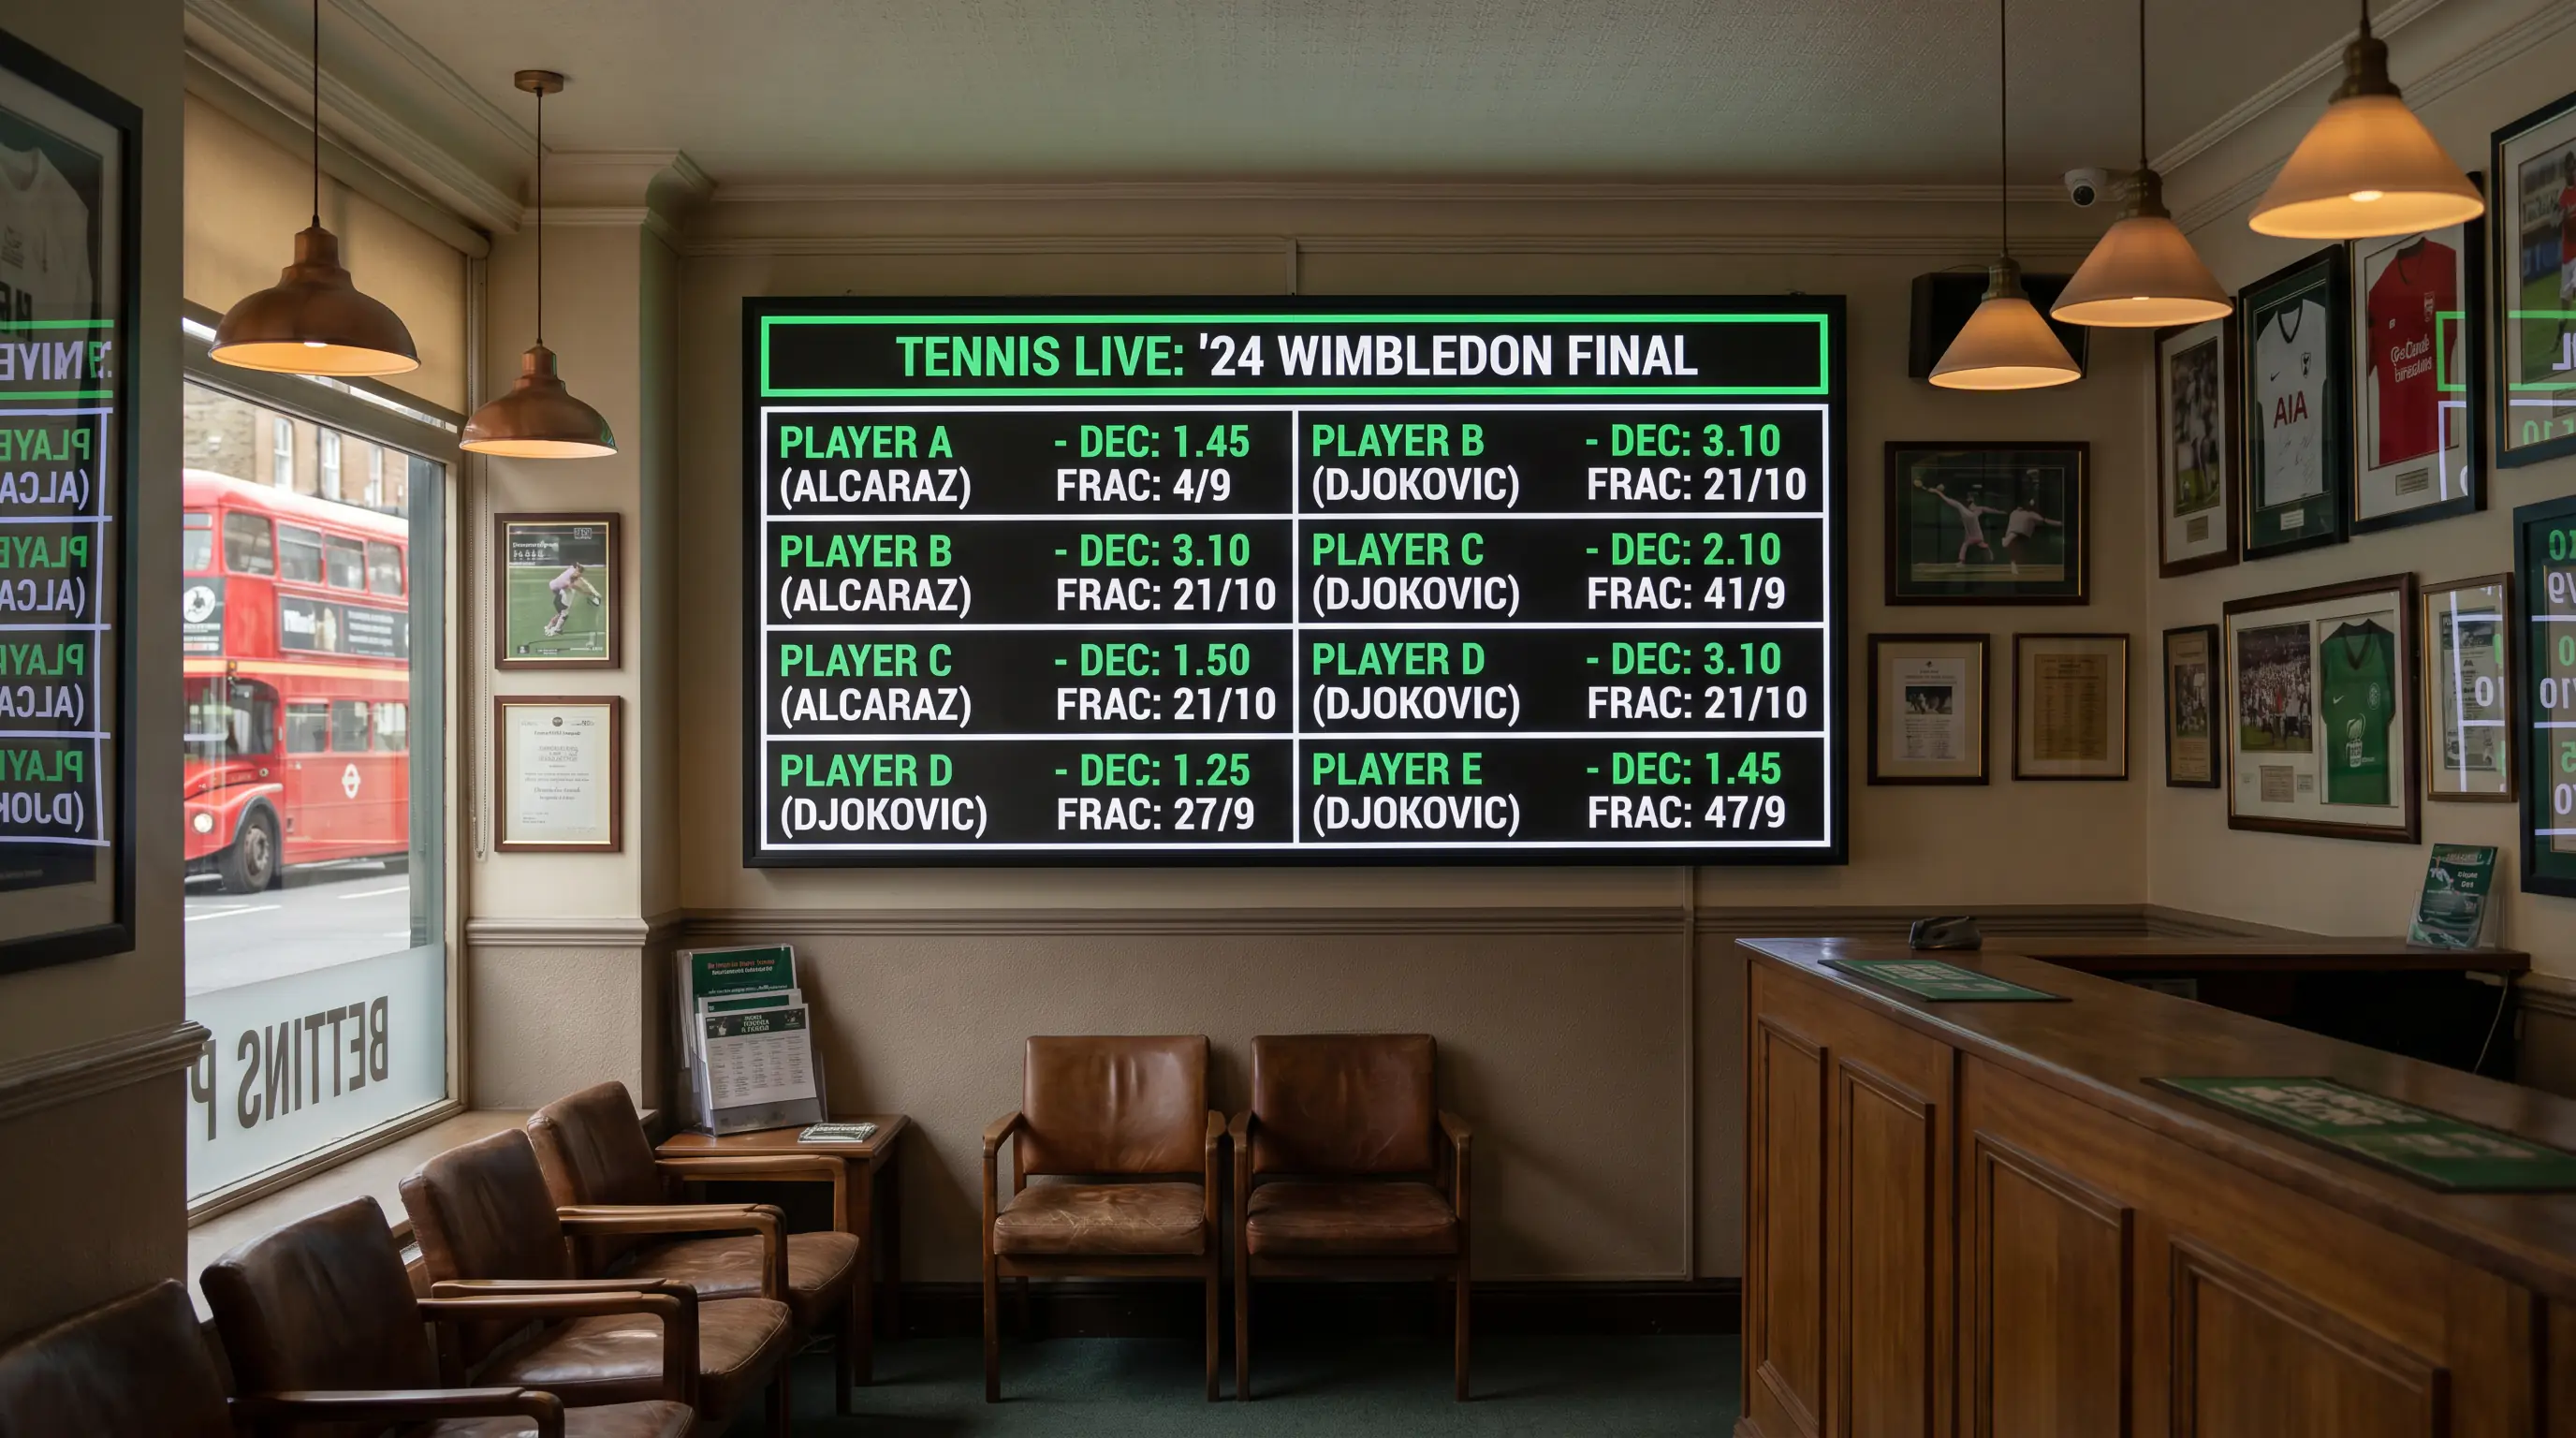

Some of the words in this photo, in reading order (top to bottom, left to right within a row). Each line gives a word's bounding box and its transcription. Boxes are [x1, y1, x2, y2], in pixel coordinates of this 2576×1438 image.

[895, 335, 1061, 377] TENNIS
[1076, 335, 1184, 376] LIVE:
[1199, 332, 1265, 376] '24
[1277, 334, 1552, 376] WIMBLEDON
[1568, 334, 1699, 376] FINAL
[2273, 390, 2309, 429] AIA
[780, 425, 918, 459] PLAYER
[928, 425, 953, 459] A
[1080, 424, 1160, 458] DEC:
[1174, 424, 1250, 458] 1.45
[1312, 423, 1450, 457] PLAYER
[1461, 423, 1485, 457] B
[1611, 423, 1690, 457] DEC:
[1702, 423, 1780, 457] 3.10
[780, 465, 972, 511] (ALCARAZ)
[1057, 468, 1161, 502] FRAC:
[1172, 467, 1231, 504] 4/9
[1312, 464, 1520, 509] (DJOKOVIC)
[1588, 466, 1691, 501] FRAC:
[1704, 466, 1807, 503] 21/10
[781, 534, 918, 568] PLAYER
[929, 534, 952, 567] B
[1080, 533, 1160, 567] DEC:
[1172, 533, 1250, 567] 3.10
[1312, 532, 1451, 566] PLAYER
[1461, 532, 1484, 566] C
[1612, 532, 1691, 566] DEC:
[1703, 532, 1781, 565] 2.10
[780, 575, 972, 620] (ALCARAZ)
[1057, 577, 1161, 611] FRAC:
[1173, 577, 1276, 612] 21/10
[1312, 573, 1520, 619] (DJOKOVIC)
[1588, 576, 1692, 610] FRAC:
[1704, 576, 1786, 611] 41/9
[781, 643, 918, 677] PLAYER
[929, 643, 952, 677] C
[1080, 642, 1160, 677] DEC:
[1174, 642, 1251, 677] 1.50
[1312, 642, 1450, 676] PLAYER
[1462, 642, 1486, 675] D
[1612, 641, 1691, 675] DEC:
[1704, 641, 1781, 675] 3.10
[781, 684, 972, 729] (ALCARAZ)
[1057, 686, 1162, 721] FRAC:
[1173, 686, 1276, 723] 21/10
[1312, 682, 1520, 728] (DJOKOVIC)
[1588, 685, 1692, 719] FRAC:
[1704, 685, 1808, 722] 21/10
[781, 754, 918, 787] PLAYER
[929, 754, 953, 786] D
[1081, 753, 1161, 787] DEC:
[1174, 753, 1251, 786] 1.25
[1312, 752, 1450, 785] PLAYER
[1462, 752, 1483, 785] E
[1612, 751, 1691, 785] DEC:
[1705, 751, 1781, 785] 1.45
[781, 794, 988, 840] (DJOKOVIC)
[1058, 797, 1162, 830] FRAC:
[1174, 797, 1254, 832] 27/9
[1312, 793, 1520, 838] (DJOKOVIC)
[1588, 795, 1692, 829] FRAC:
[1704, 795, 1786, 830] 47/9
